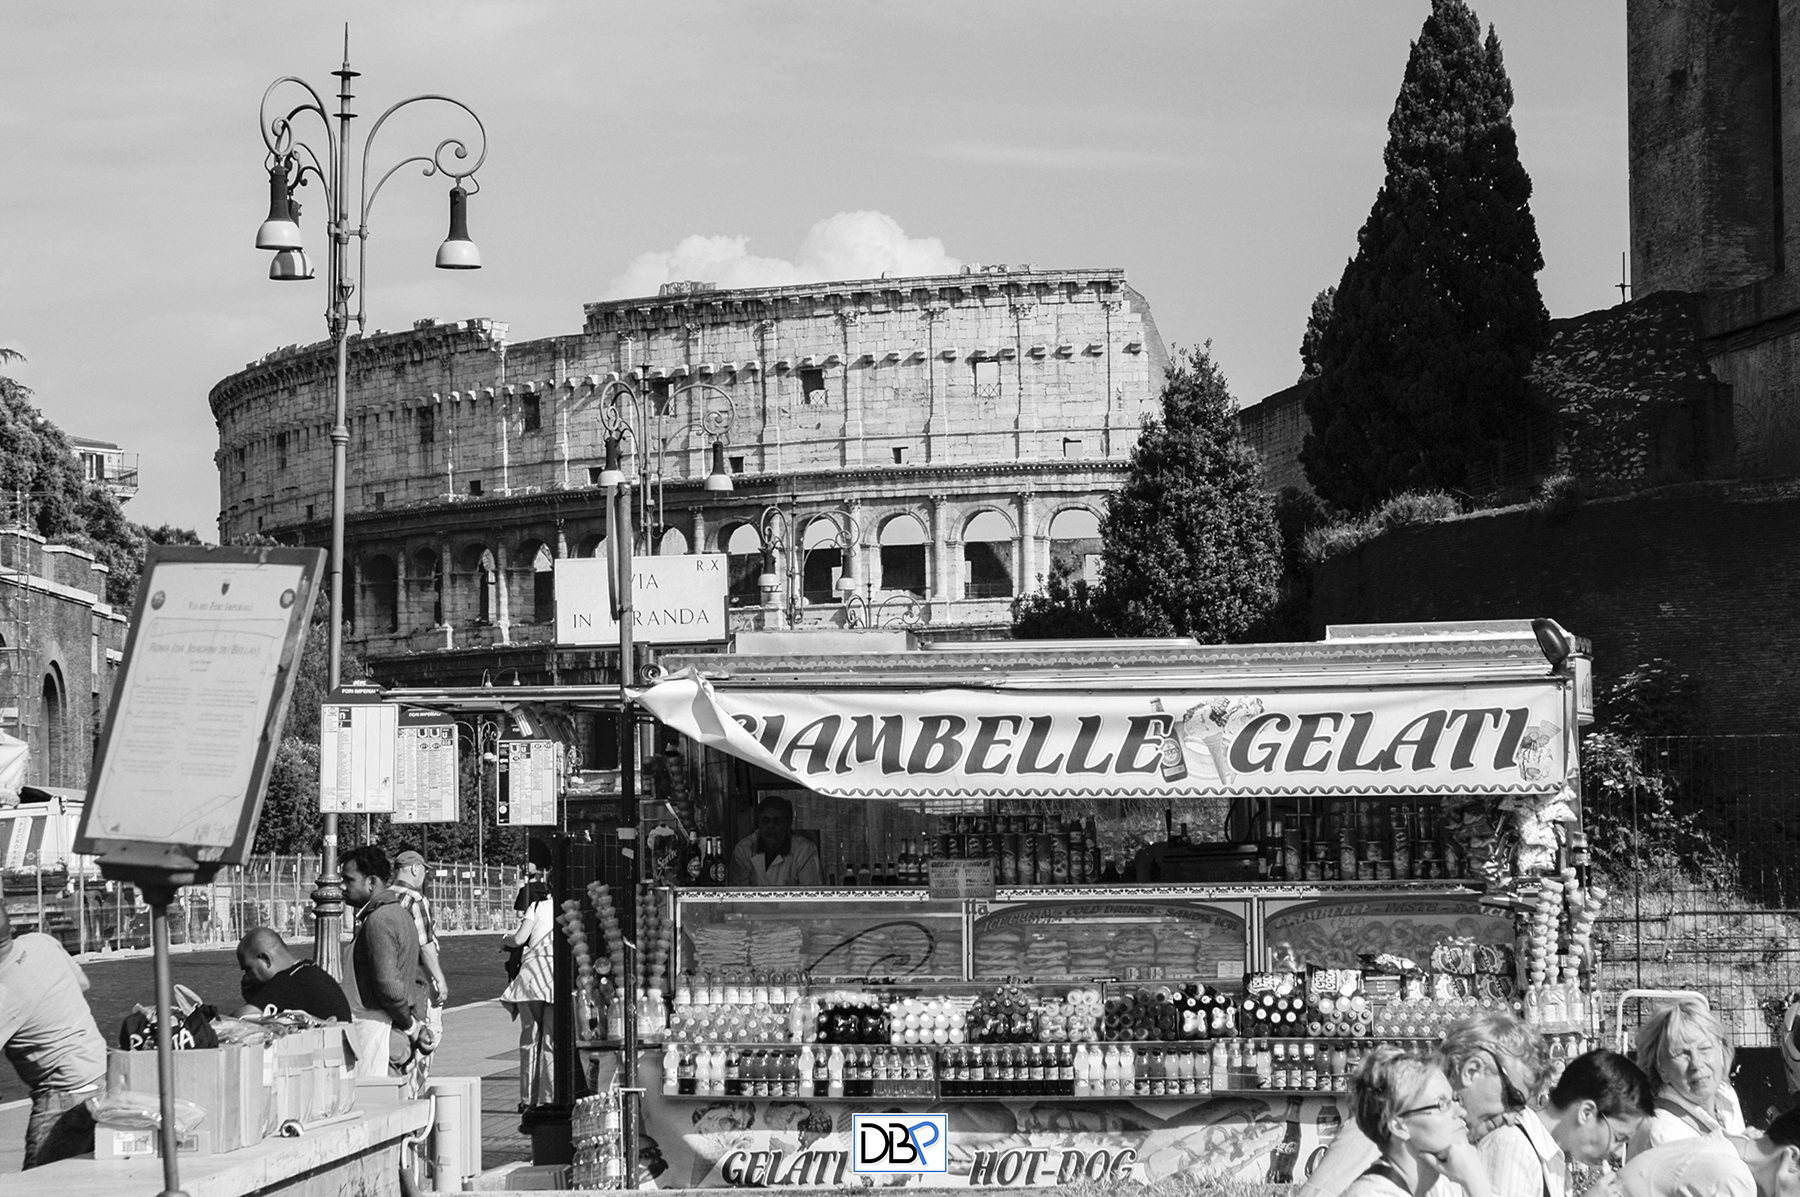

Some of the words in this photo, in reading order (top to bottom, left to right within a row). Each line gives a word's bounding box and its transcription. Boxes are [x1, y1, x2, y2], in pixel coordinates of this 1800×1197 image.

[573, 613, 592, 629] IN
[608, 608, 709, 628] RANDA
[1229, 707, 1529, 773] GELATI
[1066, 905, 1100, 915] COLD
[721, 1150, 849, 1186] GELATI
[969, 1150, 1137, 1186] HOT-DOG
